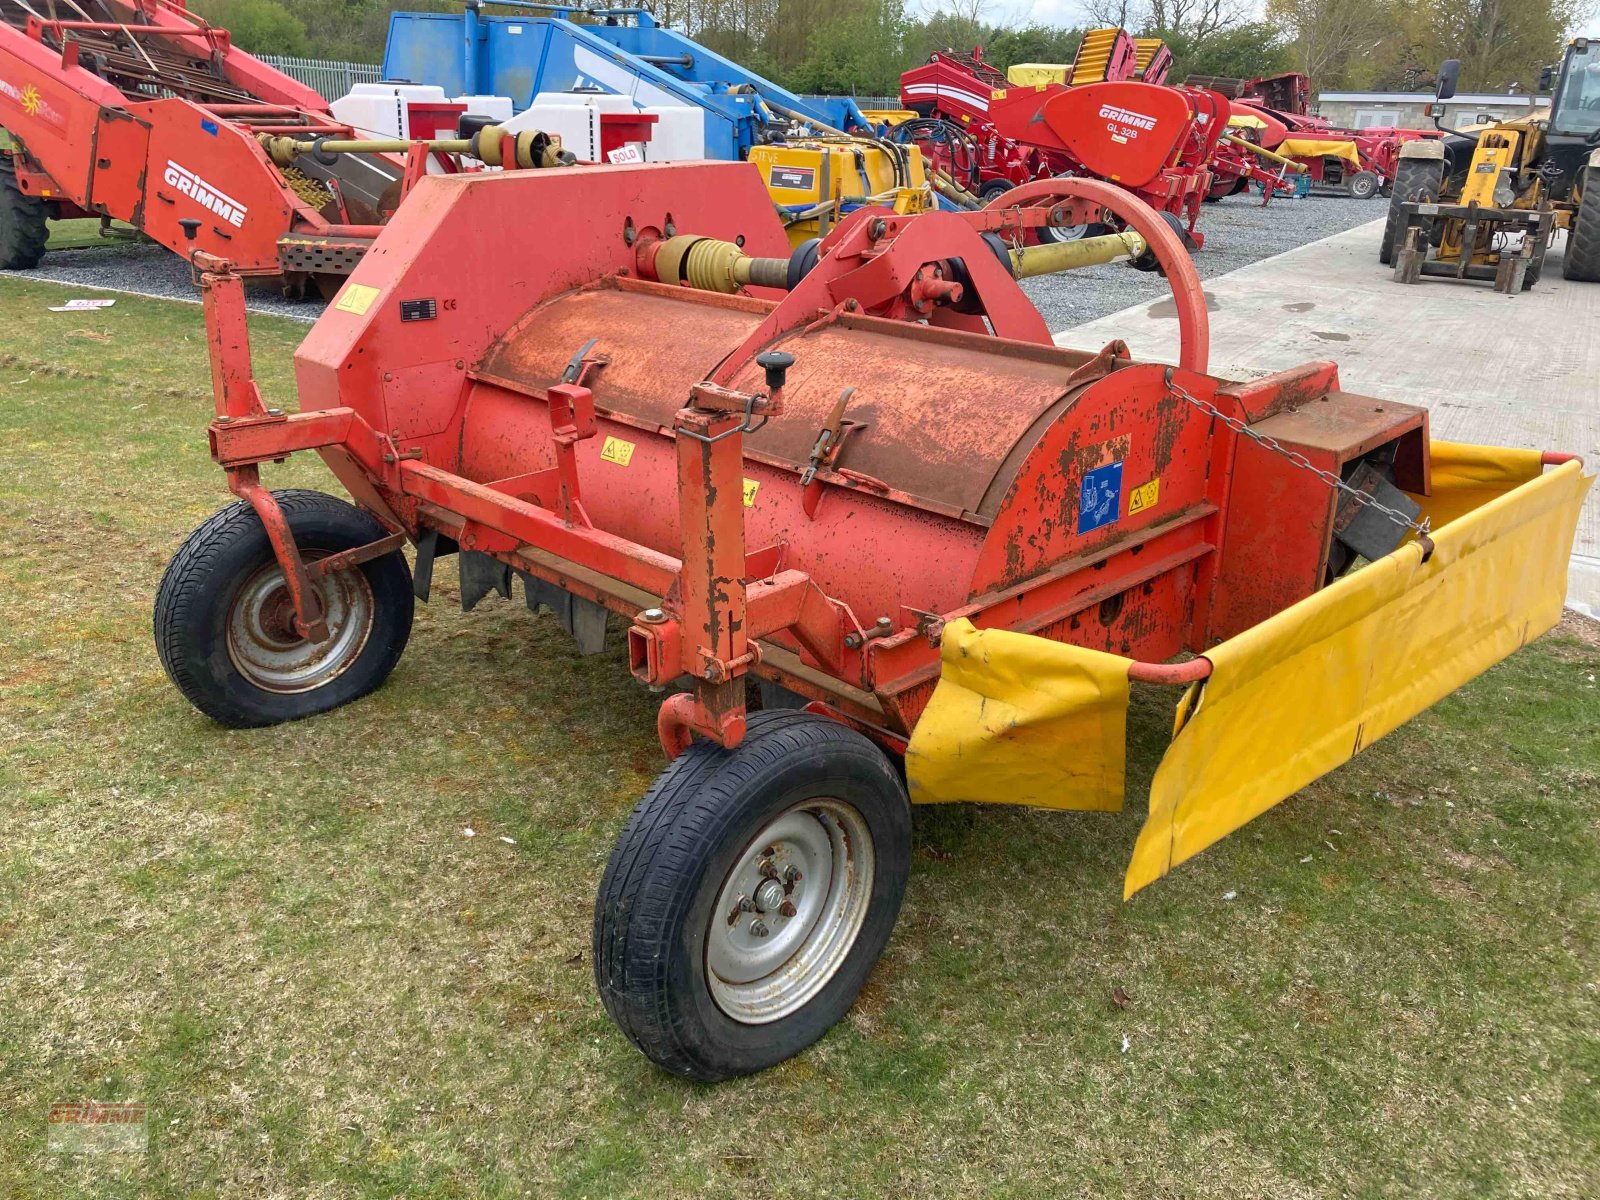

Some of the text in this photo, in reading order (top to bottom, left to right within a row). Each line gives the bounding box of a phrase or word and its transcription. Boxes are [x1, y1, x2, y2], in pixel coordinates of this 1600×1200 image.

[1099, 106, 1156, 131] GRIMME
[1107, 123, 1119, 133] GL
[613, 149, 636, 163] SOLD
[164, 163, 246, 228] GRIMME
